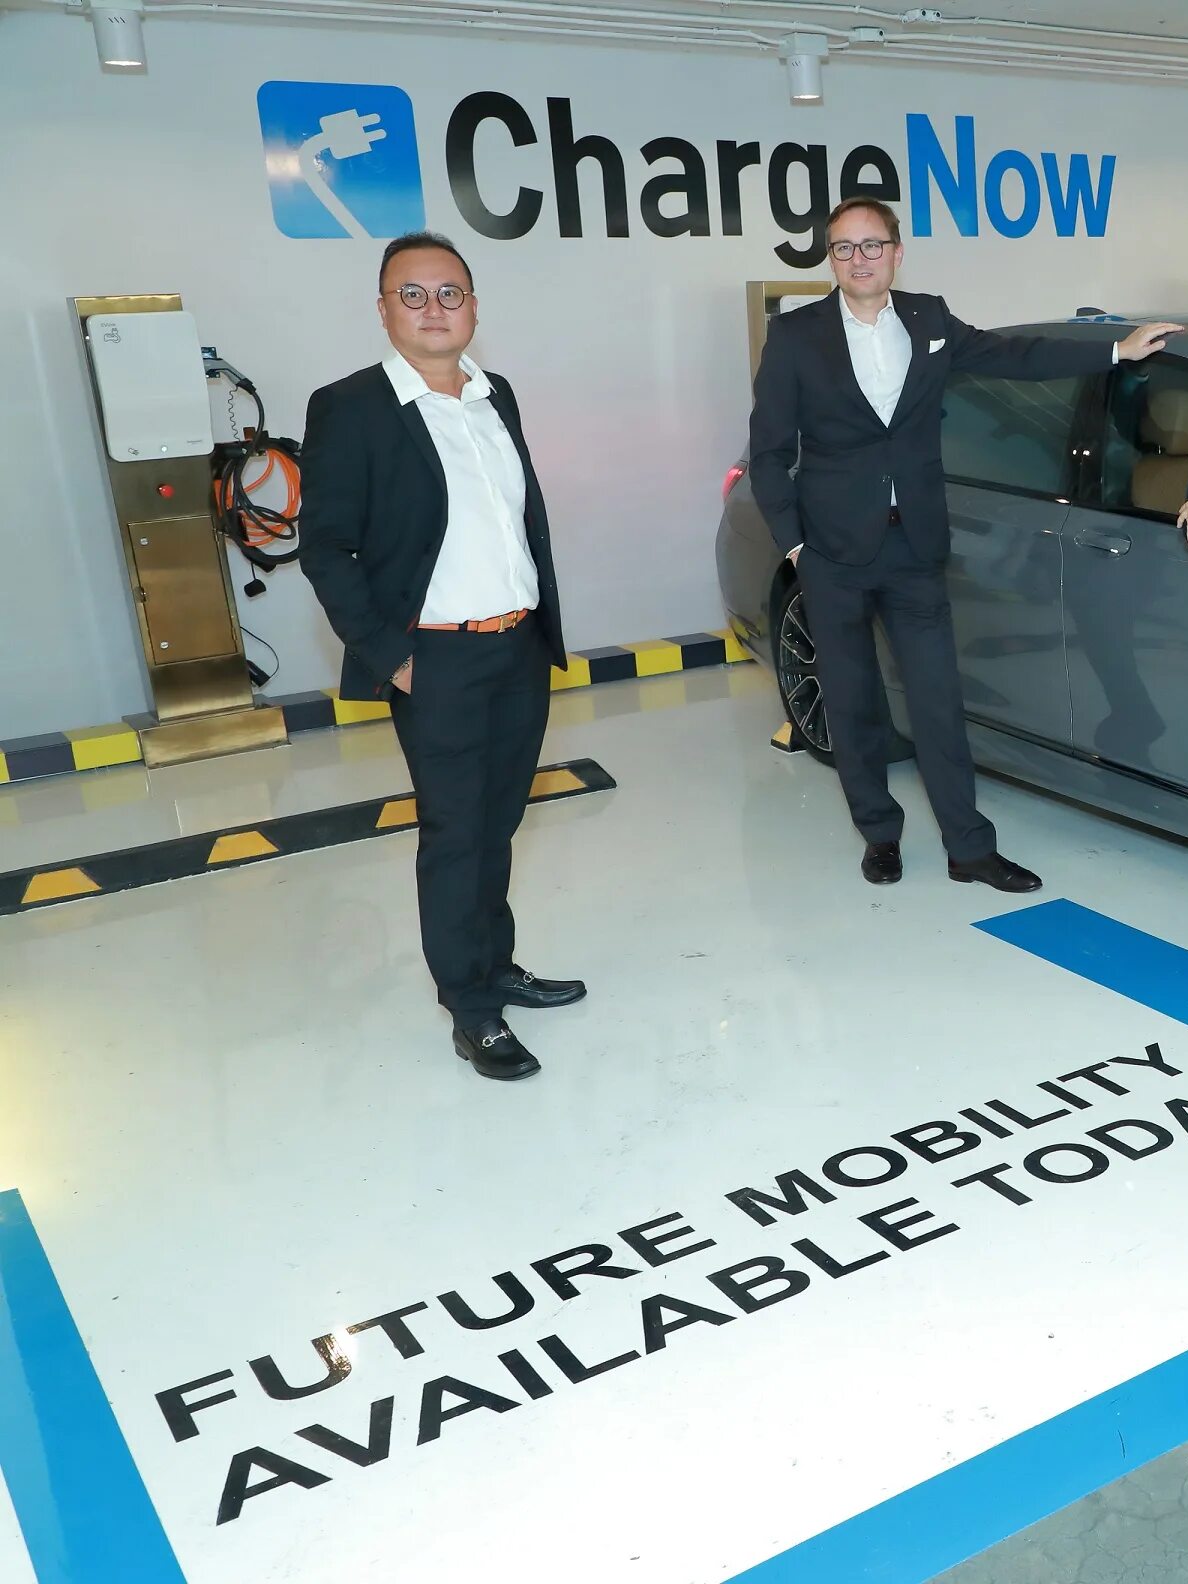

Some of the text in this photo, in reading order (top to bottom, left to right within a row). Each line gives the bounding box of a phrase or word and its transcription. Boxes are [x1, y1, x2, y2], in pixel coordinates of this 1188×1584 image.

[446, 91, 1116, 269] ChargeNow
[155, 1212, 717, 1442] FUTURE
[217, 1197, 960, 1525] AVAILABLE
